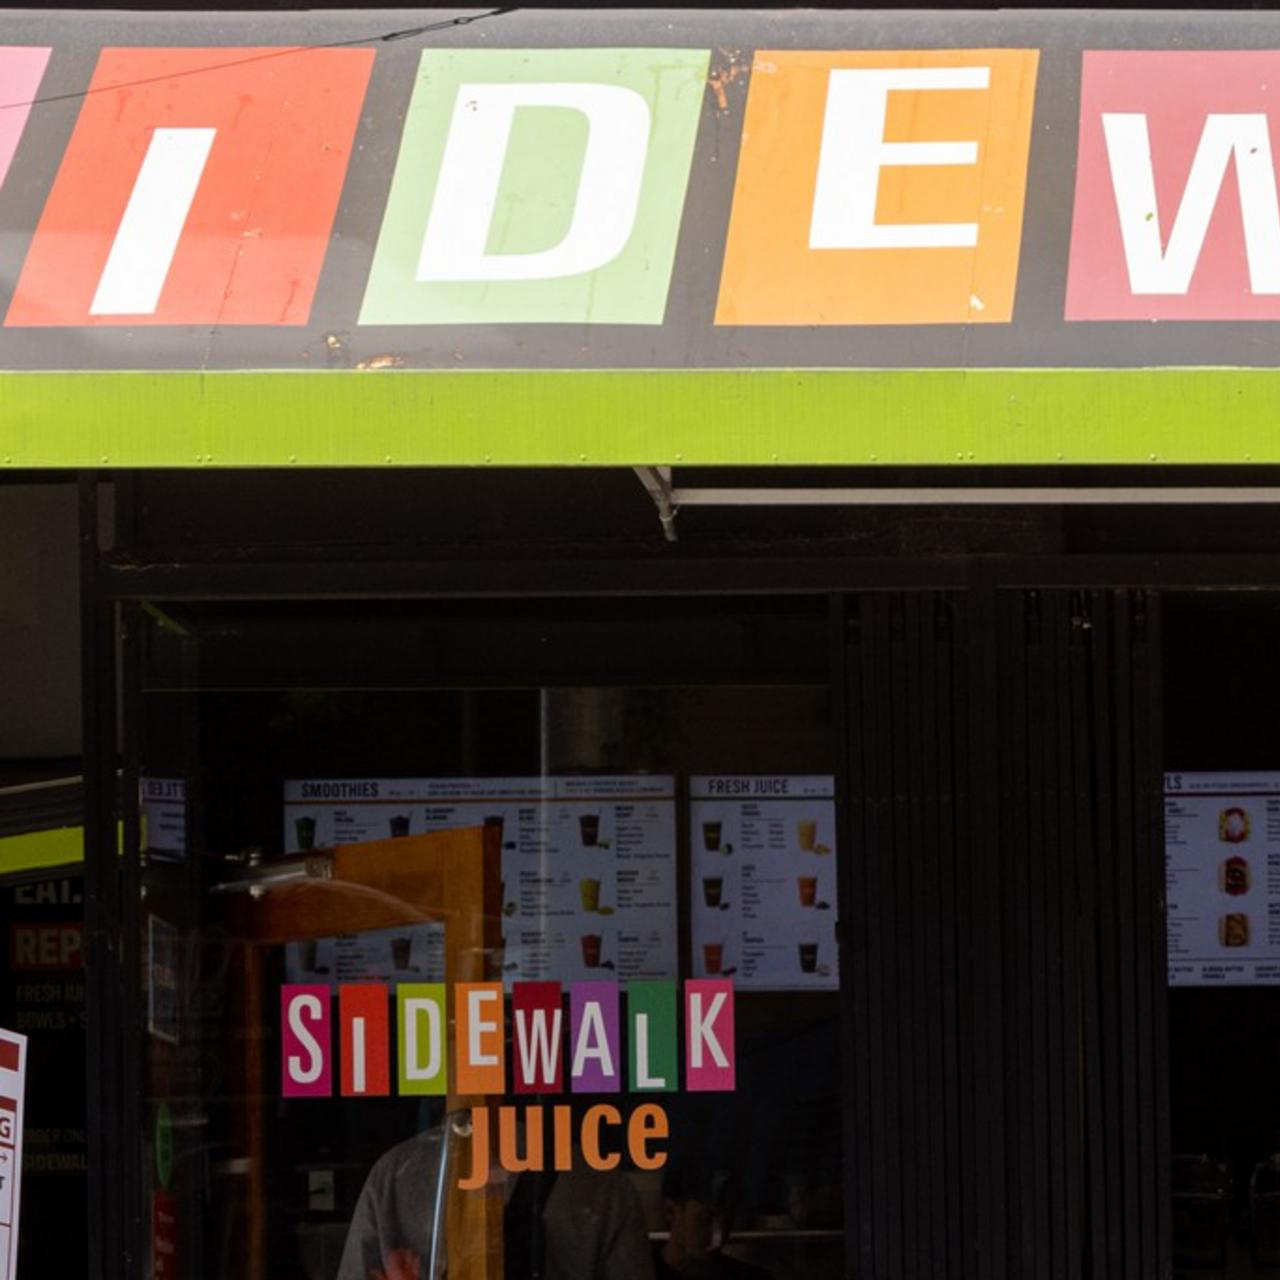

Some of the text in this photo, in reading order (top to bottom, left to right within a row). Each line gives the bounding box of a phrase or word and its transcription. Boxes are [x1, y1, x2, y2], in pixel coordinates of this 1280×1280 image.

[301, 781, 379, 798] SMOOTHIES
[708, 779, 789, 793] FRESH JUICE
[1165, 775, 1182, 790] LS
[287, 990, 730, 1093] SIDEWALK
